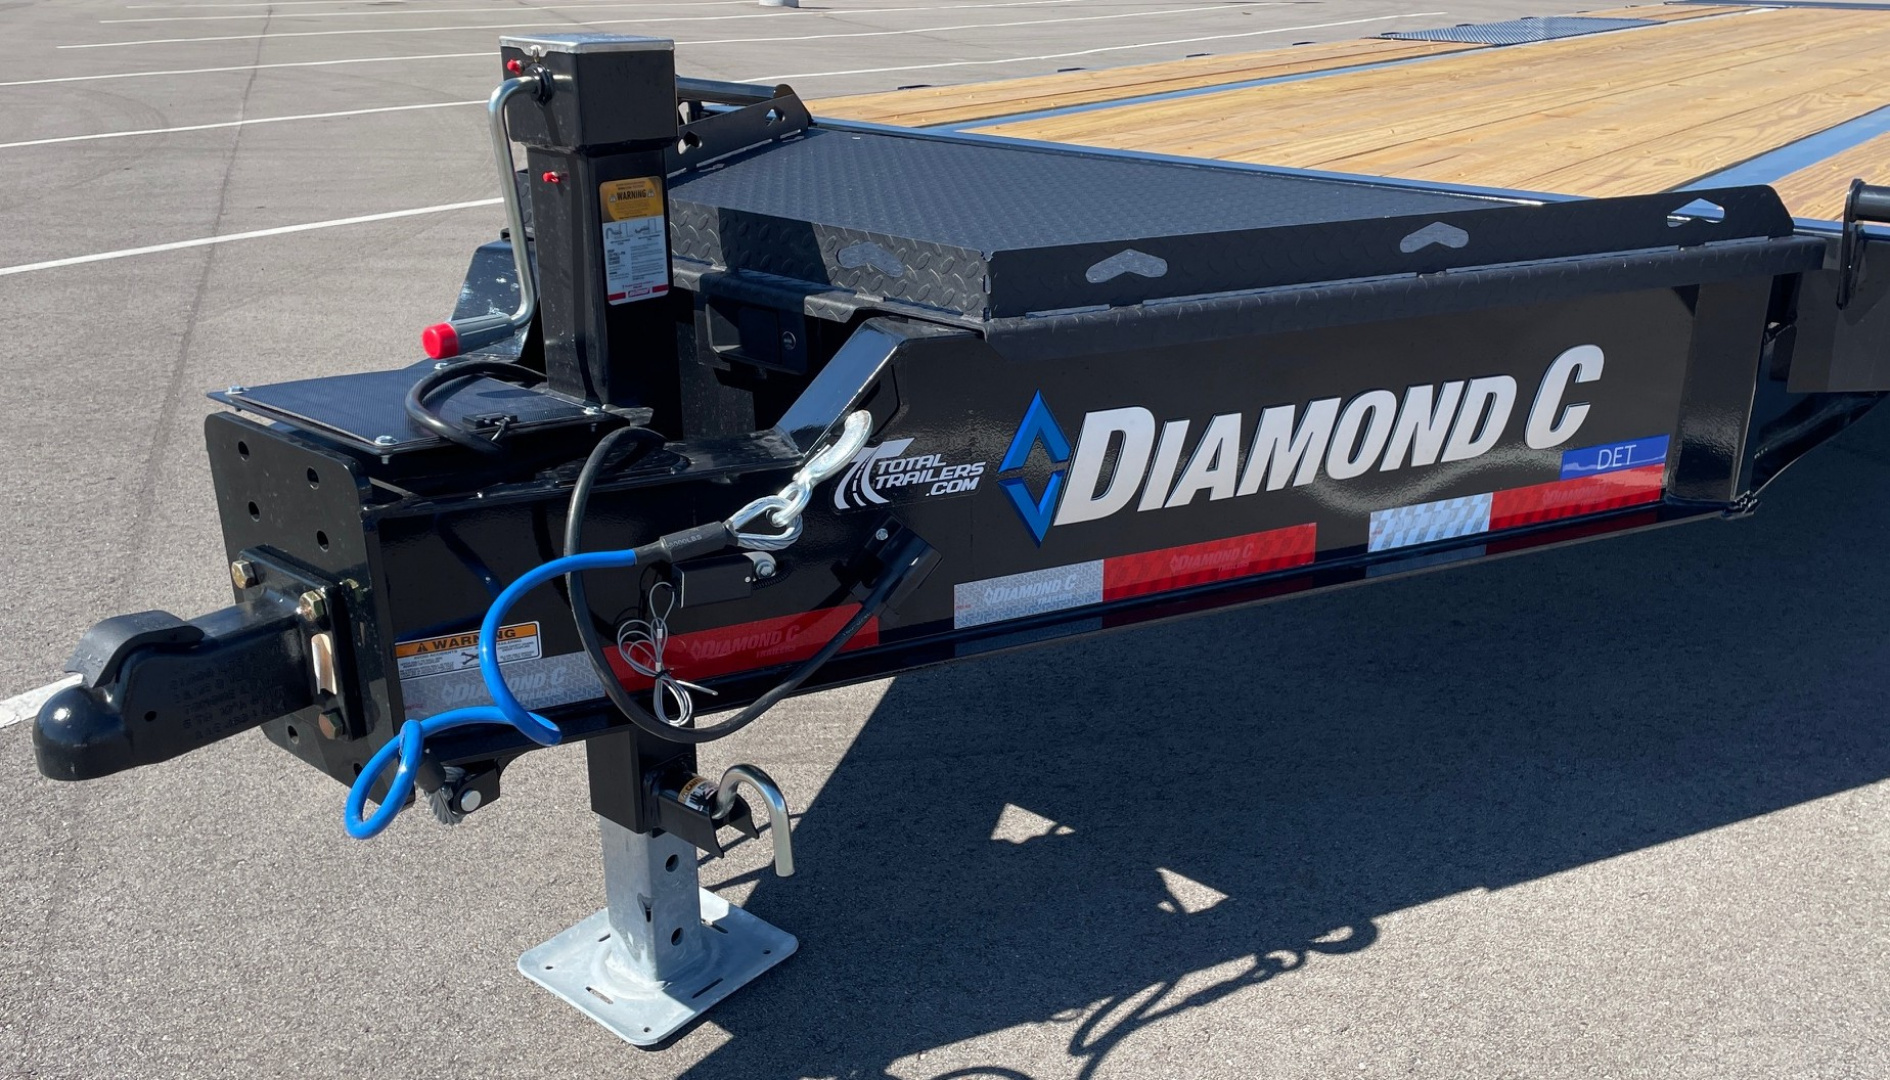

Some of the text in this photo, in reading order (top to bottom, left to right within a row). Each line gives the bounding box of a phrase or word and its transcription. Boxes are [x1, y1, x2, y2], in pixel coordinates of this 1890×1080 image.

[617, 189, 647, 201] WARNING
[1053, 344, 1605, 525] DIAMOND C
[876, 453, 946, 475] TOTAL
[1597, 444, 1637, 470] DET
[875, 461, 986, 490] TRAILERS
[925, 477, 980, 497] .COM
[1180, 542, 1254, 570] DIAMOND C
[992, 573, 1077, 604] DIAMOND C
[432, 629, 516, 650] WARNNG
[701, 625, 800, 657] DIAMOND C
[453, 667, 567, 702] DIAOND C
